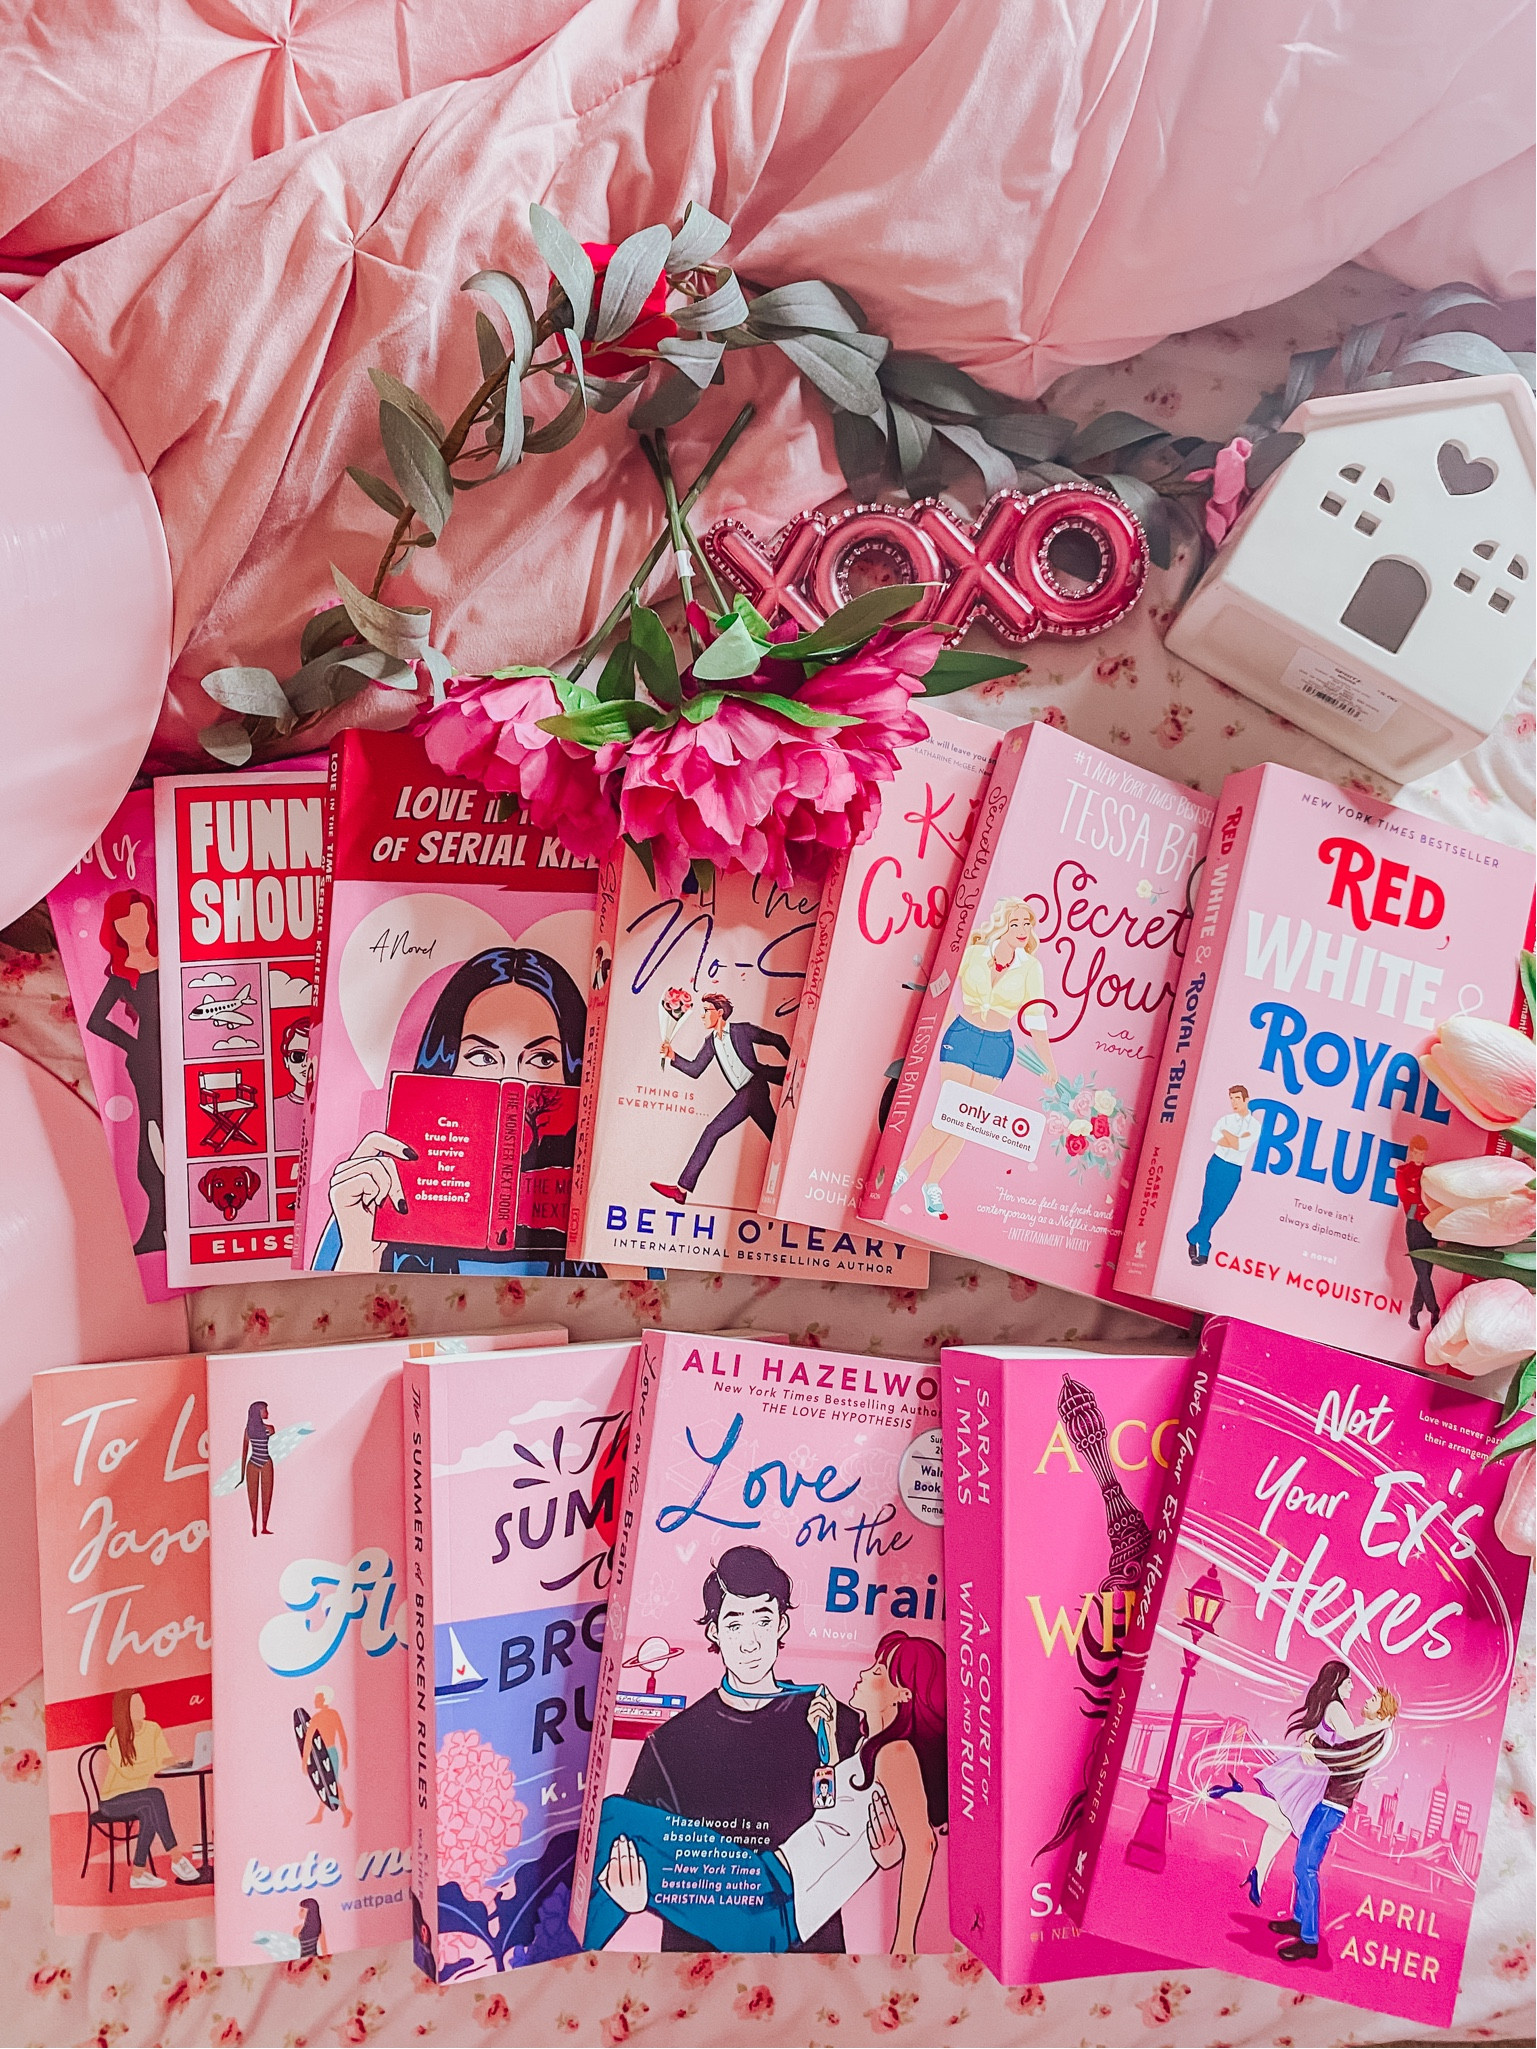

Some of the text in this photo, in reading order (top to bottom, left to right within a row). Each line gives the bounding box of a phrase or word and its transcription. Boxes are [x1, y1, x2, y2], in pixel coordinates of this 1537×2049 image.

[706, 482, 1150, 644] XOXO
[951, 744, 972, 757] leave
[395, 786, 478, 822] LOVE
[1093, 760, 1176, 812] NEW YORK TIMES
[189, 797, 322, 873] FUNN
[324, 753, 339, 884] LOVE TIME
[1059, 778, 1200, 882] TESSA BA
[1302, 793, 1500, 869] NEW YORK TIMES BESTSELLER
[371, 830, 528, 867] OF SERIAL
[950, 786, 1008, 954] Secretly Yours
[191, 877, 321, 945] SHOU
[857, 855, 949, 944] Cro
[1317, 836, 1451, 951] RED,
[312, 876, 326, 1008] SERIAL KILLERS
[370, 928, 438, 963] A Novel
[1159, 862, 1229, 1124] WHITE & ROYAL BLUE
[1243, 909, 1445, 1032] WHITE
[1095, 1039, 1155, 1060] novel
[1107, 1028, 1135, 1041] a
[889, 1012, 938, 1133] TESSA BAILEY
[1249, 1001, 1453, 1126] ROYAL
[636, 1085, 695, 1101] TIMING IS
[958, 1102, 1009, 1129] only at
[424, 1133, 470, 1144] true love
[437, 1117, 459, 1129] Can
[940, 1112, 1031, 1152] Bonus Exclusive Content
[427, 1148, 465, 1159] survive
[437, 1161, 456, 1173] her
[498, 1090, 519, 1221] THE MONSTER DOOR
[1247, 1097, 1413, 1208] BLUE
[415, 1191, 471, 1204] obsession?
[416, 1176, 471, 1188] true crime
[525, 1178, 549, 1195] THE
[1138, 1146, 1160, 1227] McQUISTON
[1149, 1165, 1164, 1209] CASEY
[606, 1205, 716, 1241] BETH
[738, 1219, 908, 1261] O'LEARY
[976, 1203, 1088, 1234] contemporary Netflix
[1093, 1207, 1114, 1220] and
[1279, 1212, 1361, 1244] always diplomatic.
[1293, 1197, 1355, 1223] True love isn't
[212, 1232, 295, 1256] ELISS
[612, 1237, 894, 1276] INTERNATIONAL BESTSELLING AUTHOR
[1064, 1236, 1092, 1252] WEEKLY
[1312, 1250, 1338, 1267] novel
[1215, 1250, 1405, 1315] CASEY McQUISTON
[681, 1348, 939, 1401] ALI HAZELWO
[713, 1381, 895, 1415] New York Times Bestselling
[761, 1402, 912, 1430] THE LOVE HYPOTHESIS
[1314, 1383, 1395, 1446] Not
[1418, 1409, 1485, 1440] Love was never
[61, 1398, 139, 1486] To
[953, 1376, 973, 1505] J. MAAS
[975, 1387, 990, 1504] SARAH
[1033, 1419, 1084, 1475] A
[1424, 1432, 1447, 1447] their
[615, 1343, 657, 1586] Love Brain
[655, 1412, 862, 1534] Love
[914, 1480, 942, 1493] Book
[492, 1477, 615, 1565] SUM
[1136, 1370, 1209, 1631] Not Your Ex's Hexes
[1254, 1455, 1486, 1568] Your Ex's
[68, 1495, 210, 1584] Jaso
[795, 1503, 914, 1564] on the
[411, 1383, 428, 1811] The SUMMER BROKEN RULES
[825, 1566, 946, 1622] Brai
[1254, 1533, 1464, 1662] Hexes
[67, 1584, 211, 1677] Thor
[808, 1627, 858, 1642] A Novel
[189, 1693, 205, 1706] a
[957, 1581, 976, 1822] WINGS AND RUIN
[977, 1613, 991, 1768] A COURT
[532, 1685, 594, 1755] RU
[1088, 1687, 1127, 1825] APRIL ASHER
[541, 1782, 567, 1806] K.
[583, 1704, 609, 1865] HAZELWOOD
[662, 1830, 771, 1846] absolute romance
[665, 1815, 770, 1831] "Hazelwood is an
[241, 1851, 342, 1898] kate
[674, 1846, 759, 1861] powerhouse."
[702, 1863, 762, 1876] York Times
[340, 1889, 404, 1912] wattpad
[654, 1892, 765, 1907] CHRISTINA LAUREN
[661, 1878, 762, 1893] bestselling author
[1355, 1894, 1441, 1940] APRIL
[1339, 1935, 1441, 1984] ASHER
